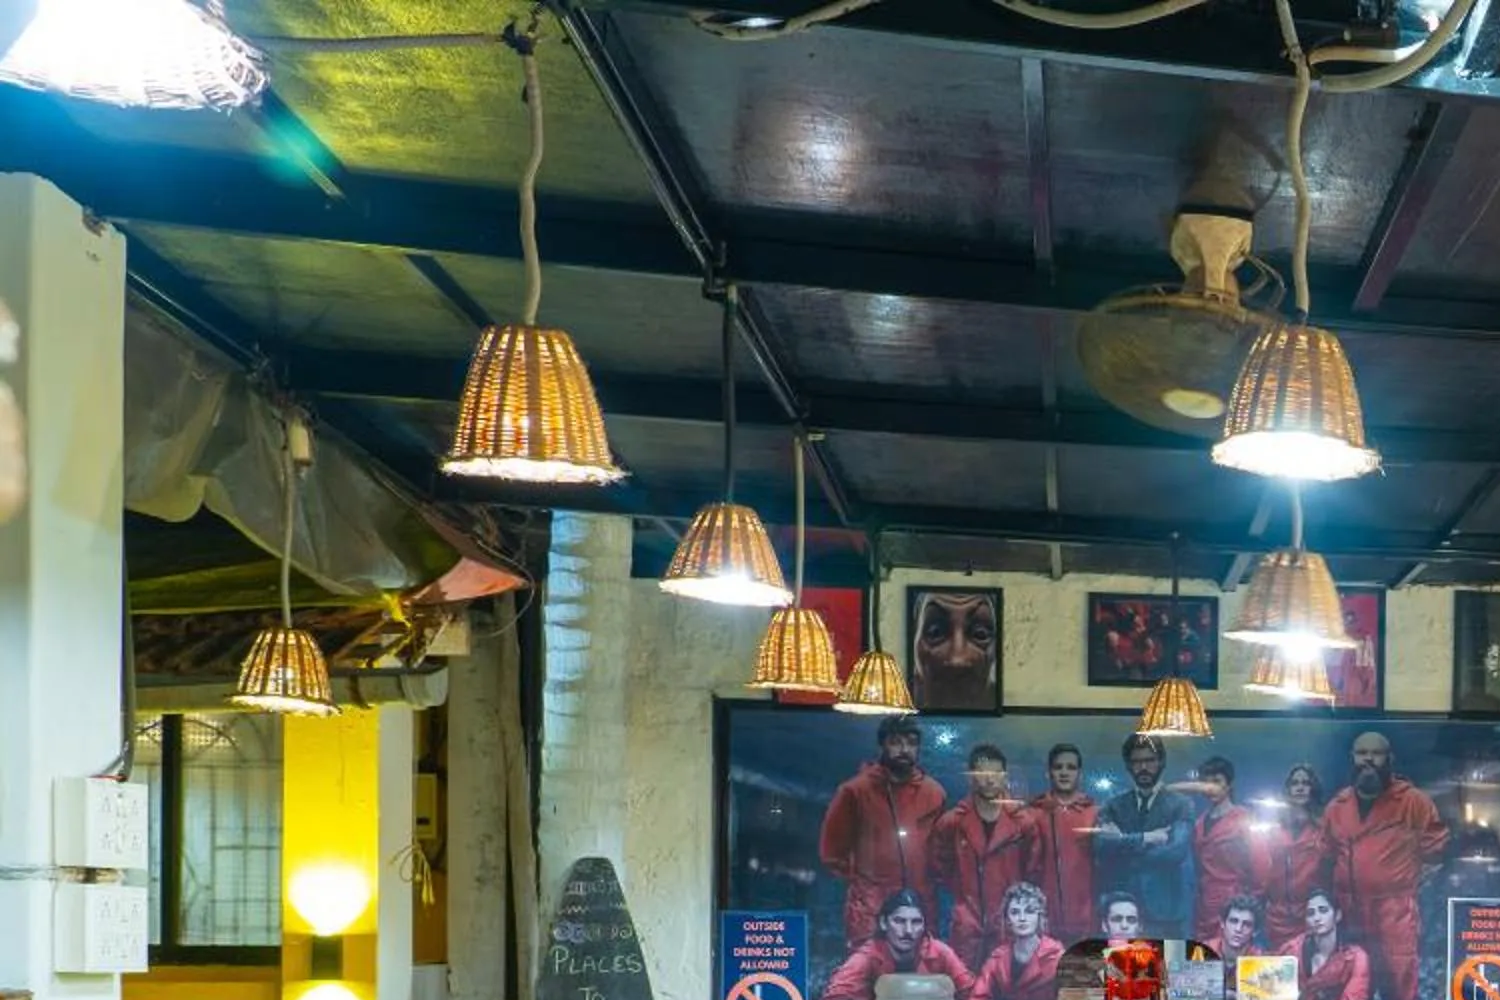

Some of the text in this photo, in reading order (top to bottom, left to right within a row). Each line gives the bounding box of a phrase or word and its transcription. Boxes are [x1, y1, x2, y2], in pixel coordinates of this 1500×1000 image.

[743, 921, 785, 931] OUTSIDE
[745, 935, 774, 945] FOOD
[733, 947, 796, 957] DRINKS NOT
[551, 946, 642, 974] PLACES
[740, 960, 790, 970] ALLOWED
